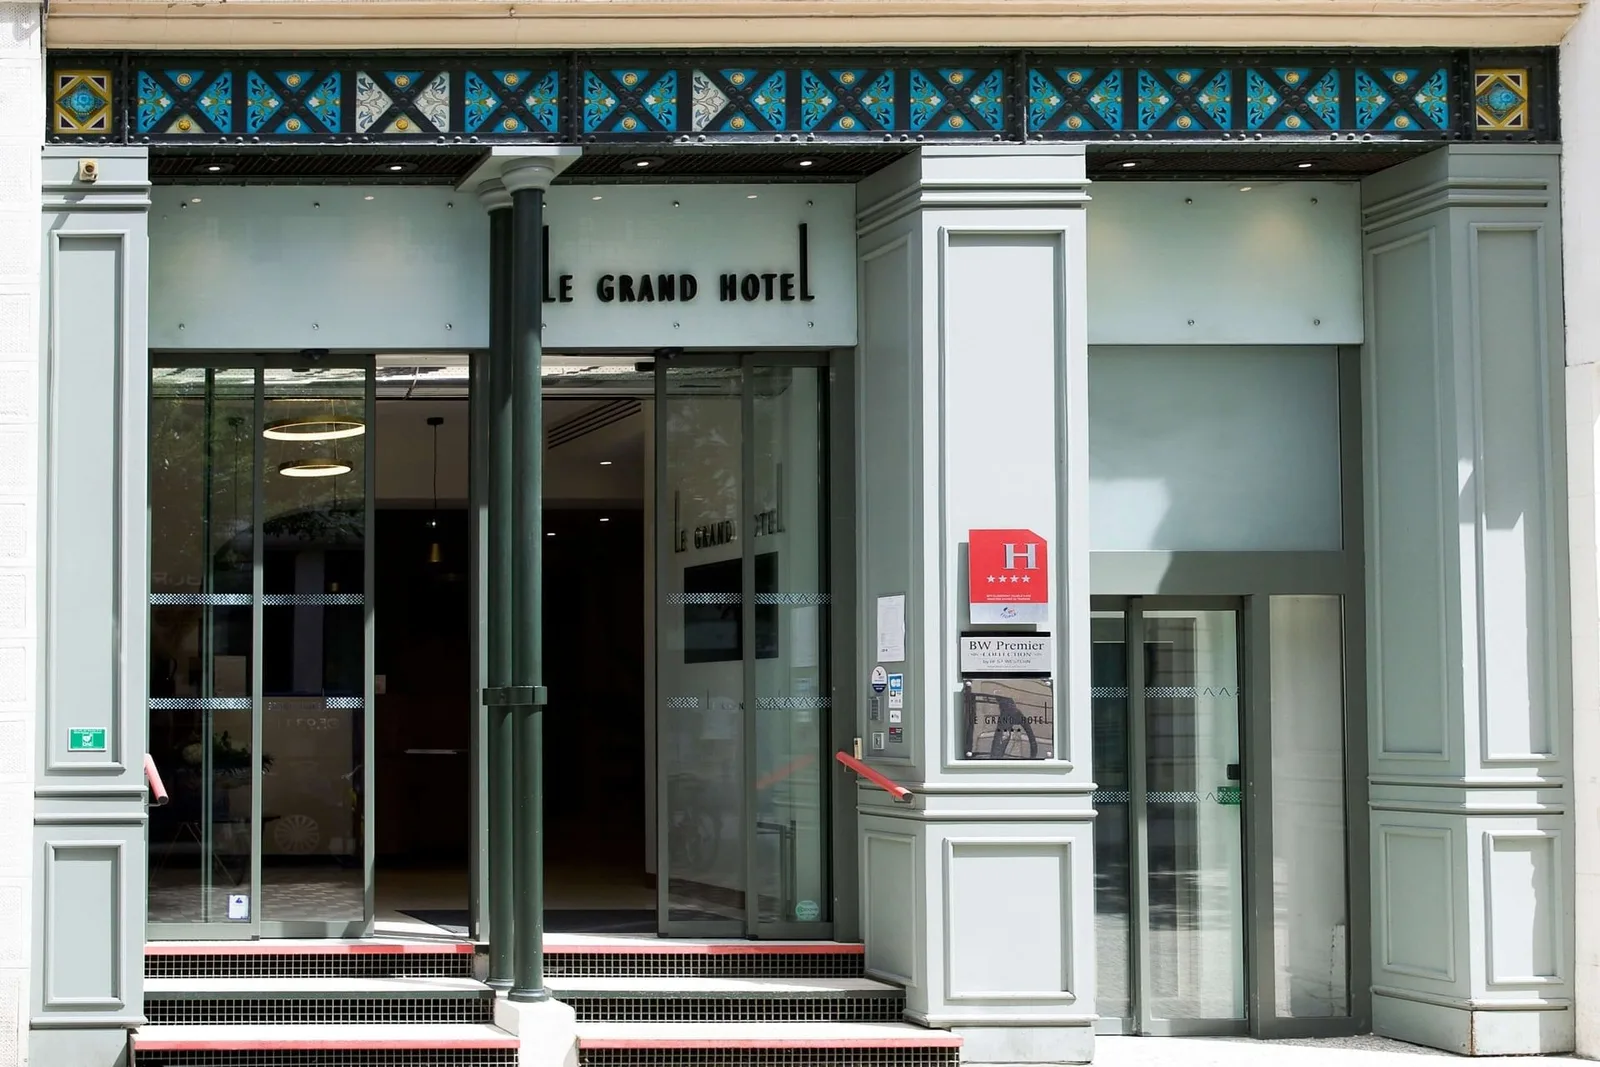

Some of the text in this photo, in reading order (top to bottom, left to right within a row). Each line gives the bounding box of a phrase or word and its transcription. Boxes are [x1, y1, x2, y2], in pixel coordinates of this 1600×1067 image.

[542, 222, 815, 303] LE GRAND HOTEL
[1002, 542, 1040, 571] H
[969, 640, 1045, 651] BW Premier
